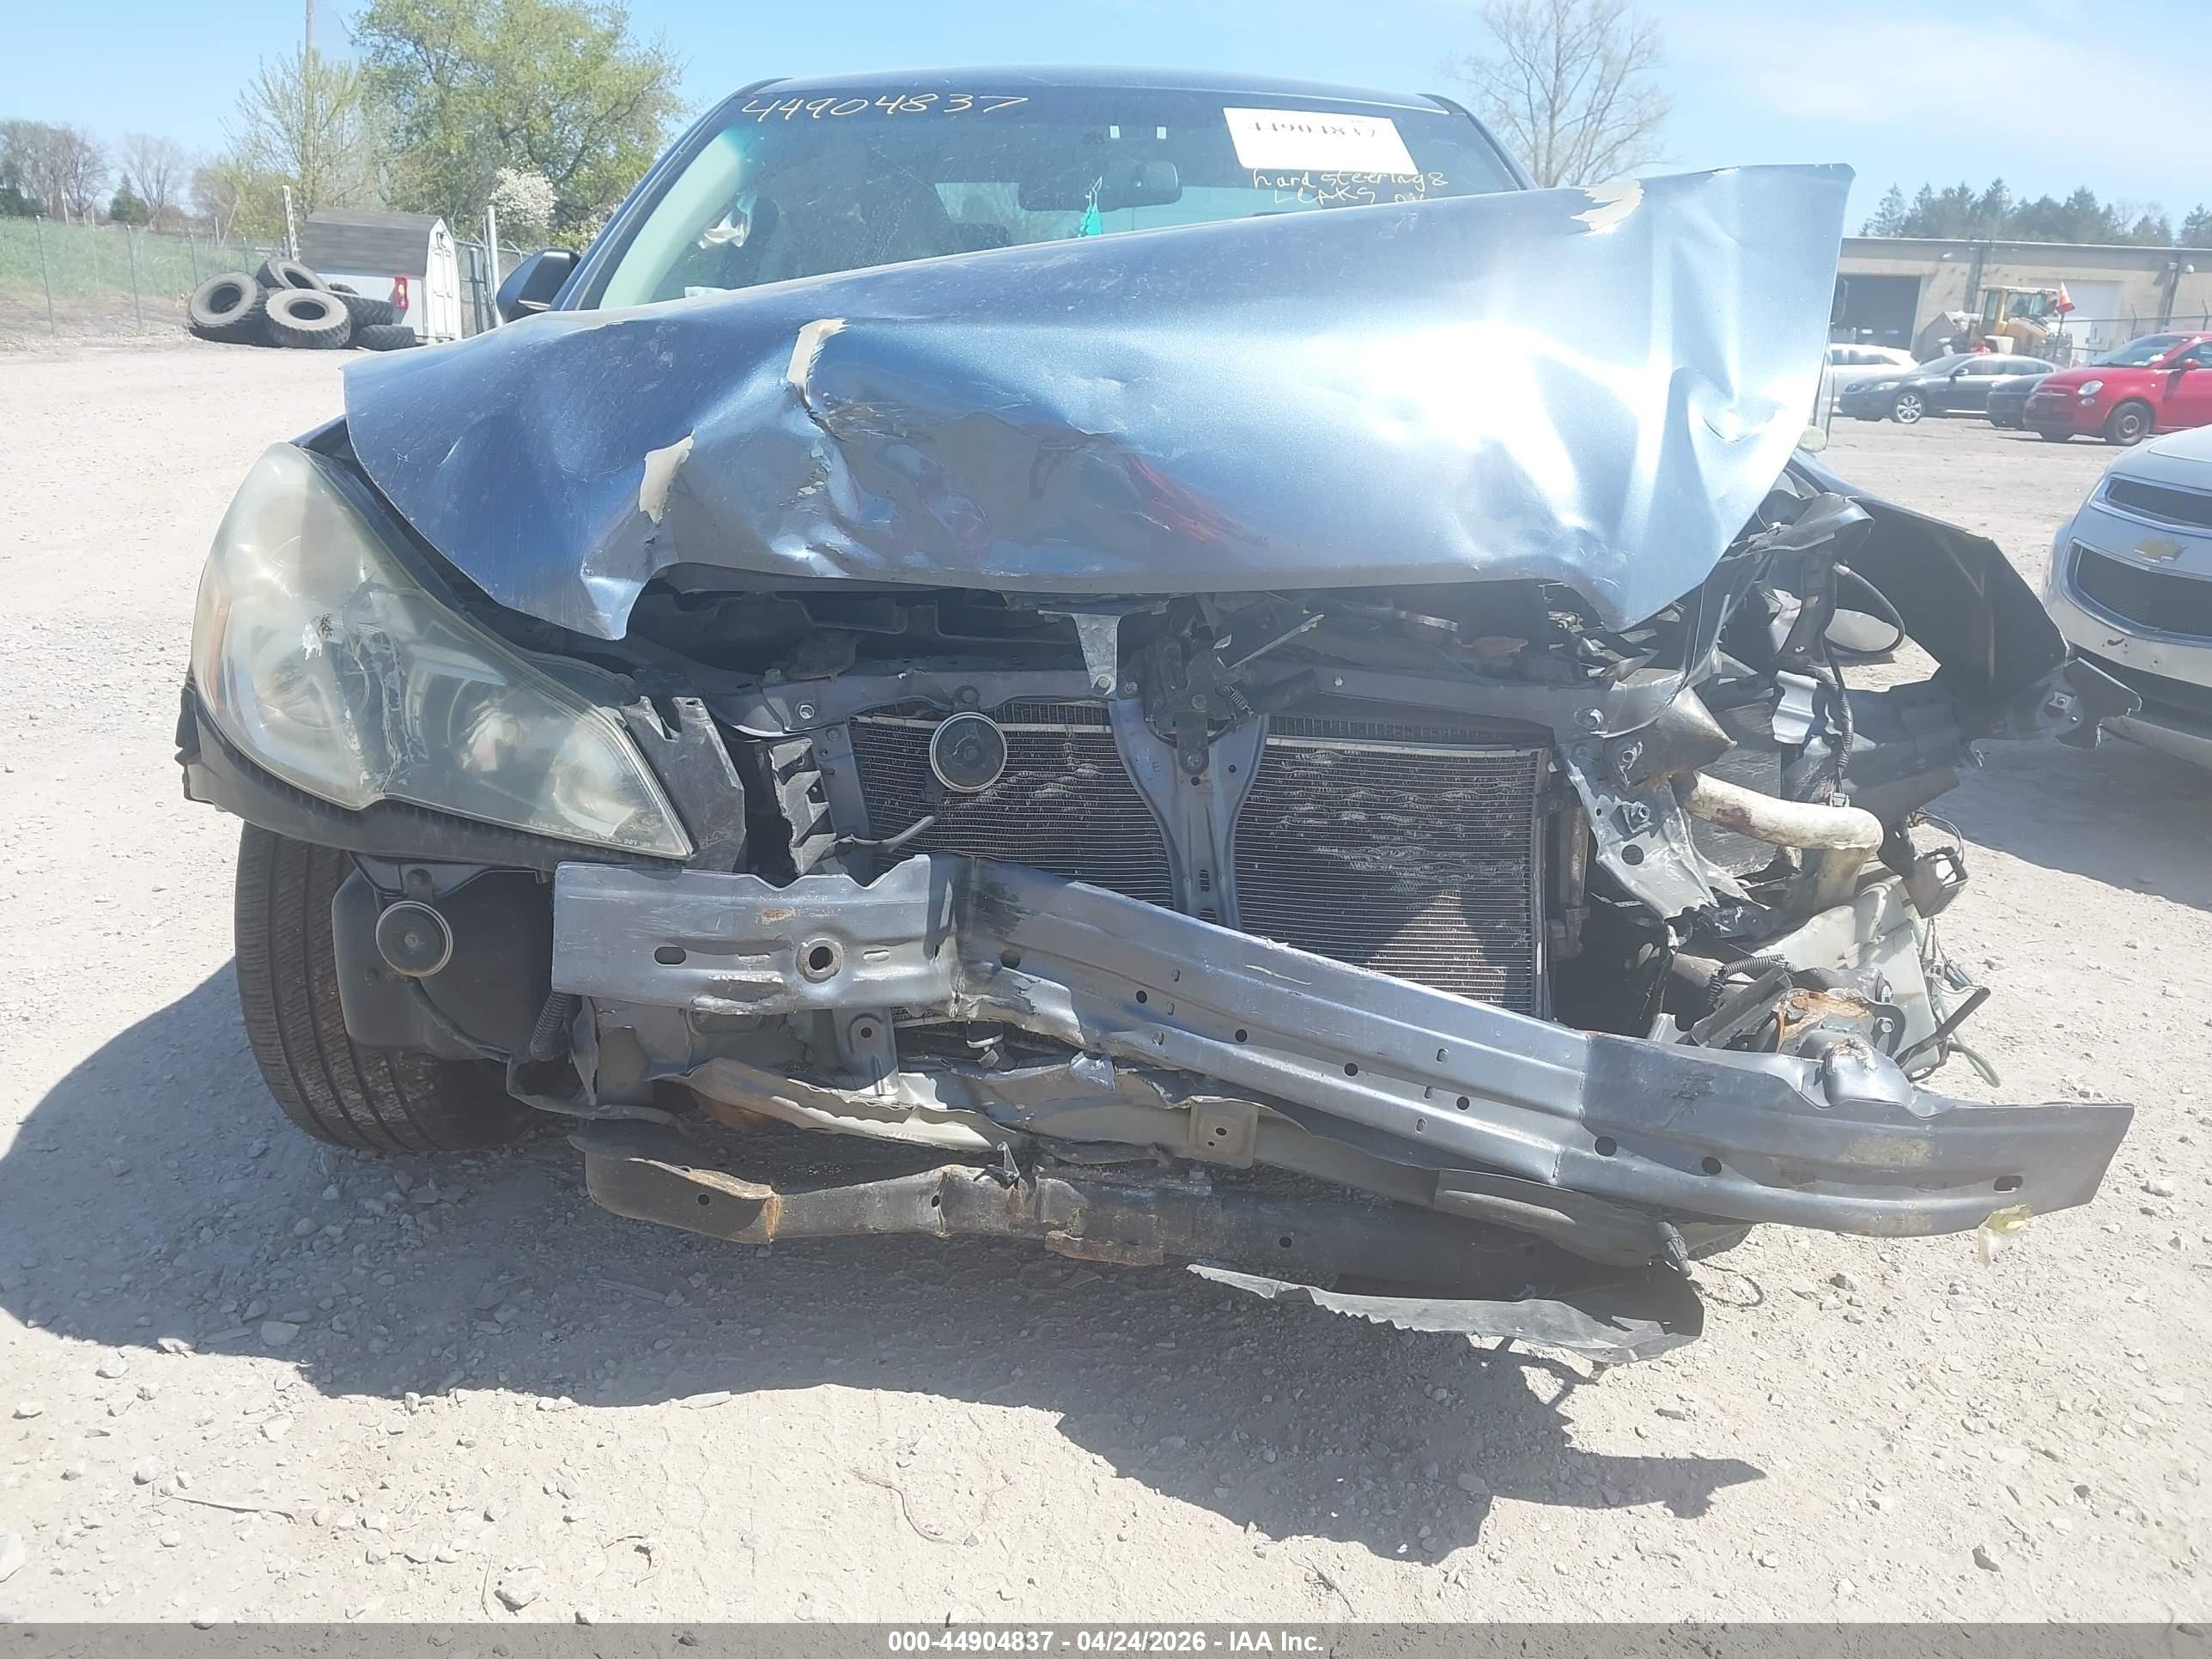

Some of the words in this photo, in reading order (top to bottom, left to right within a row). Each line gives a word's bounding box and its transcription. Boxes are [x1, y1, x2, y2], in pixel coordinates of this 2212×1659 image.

[741, 93, 1030, 122] 44904837
[1253, 168, 1317, 188] hard
[1321, 171, 1425, 192] steering
